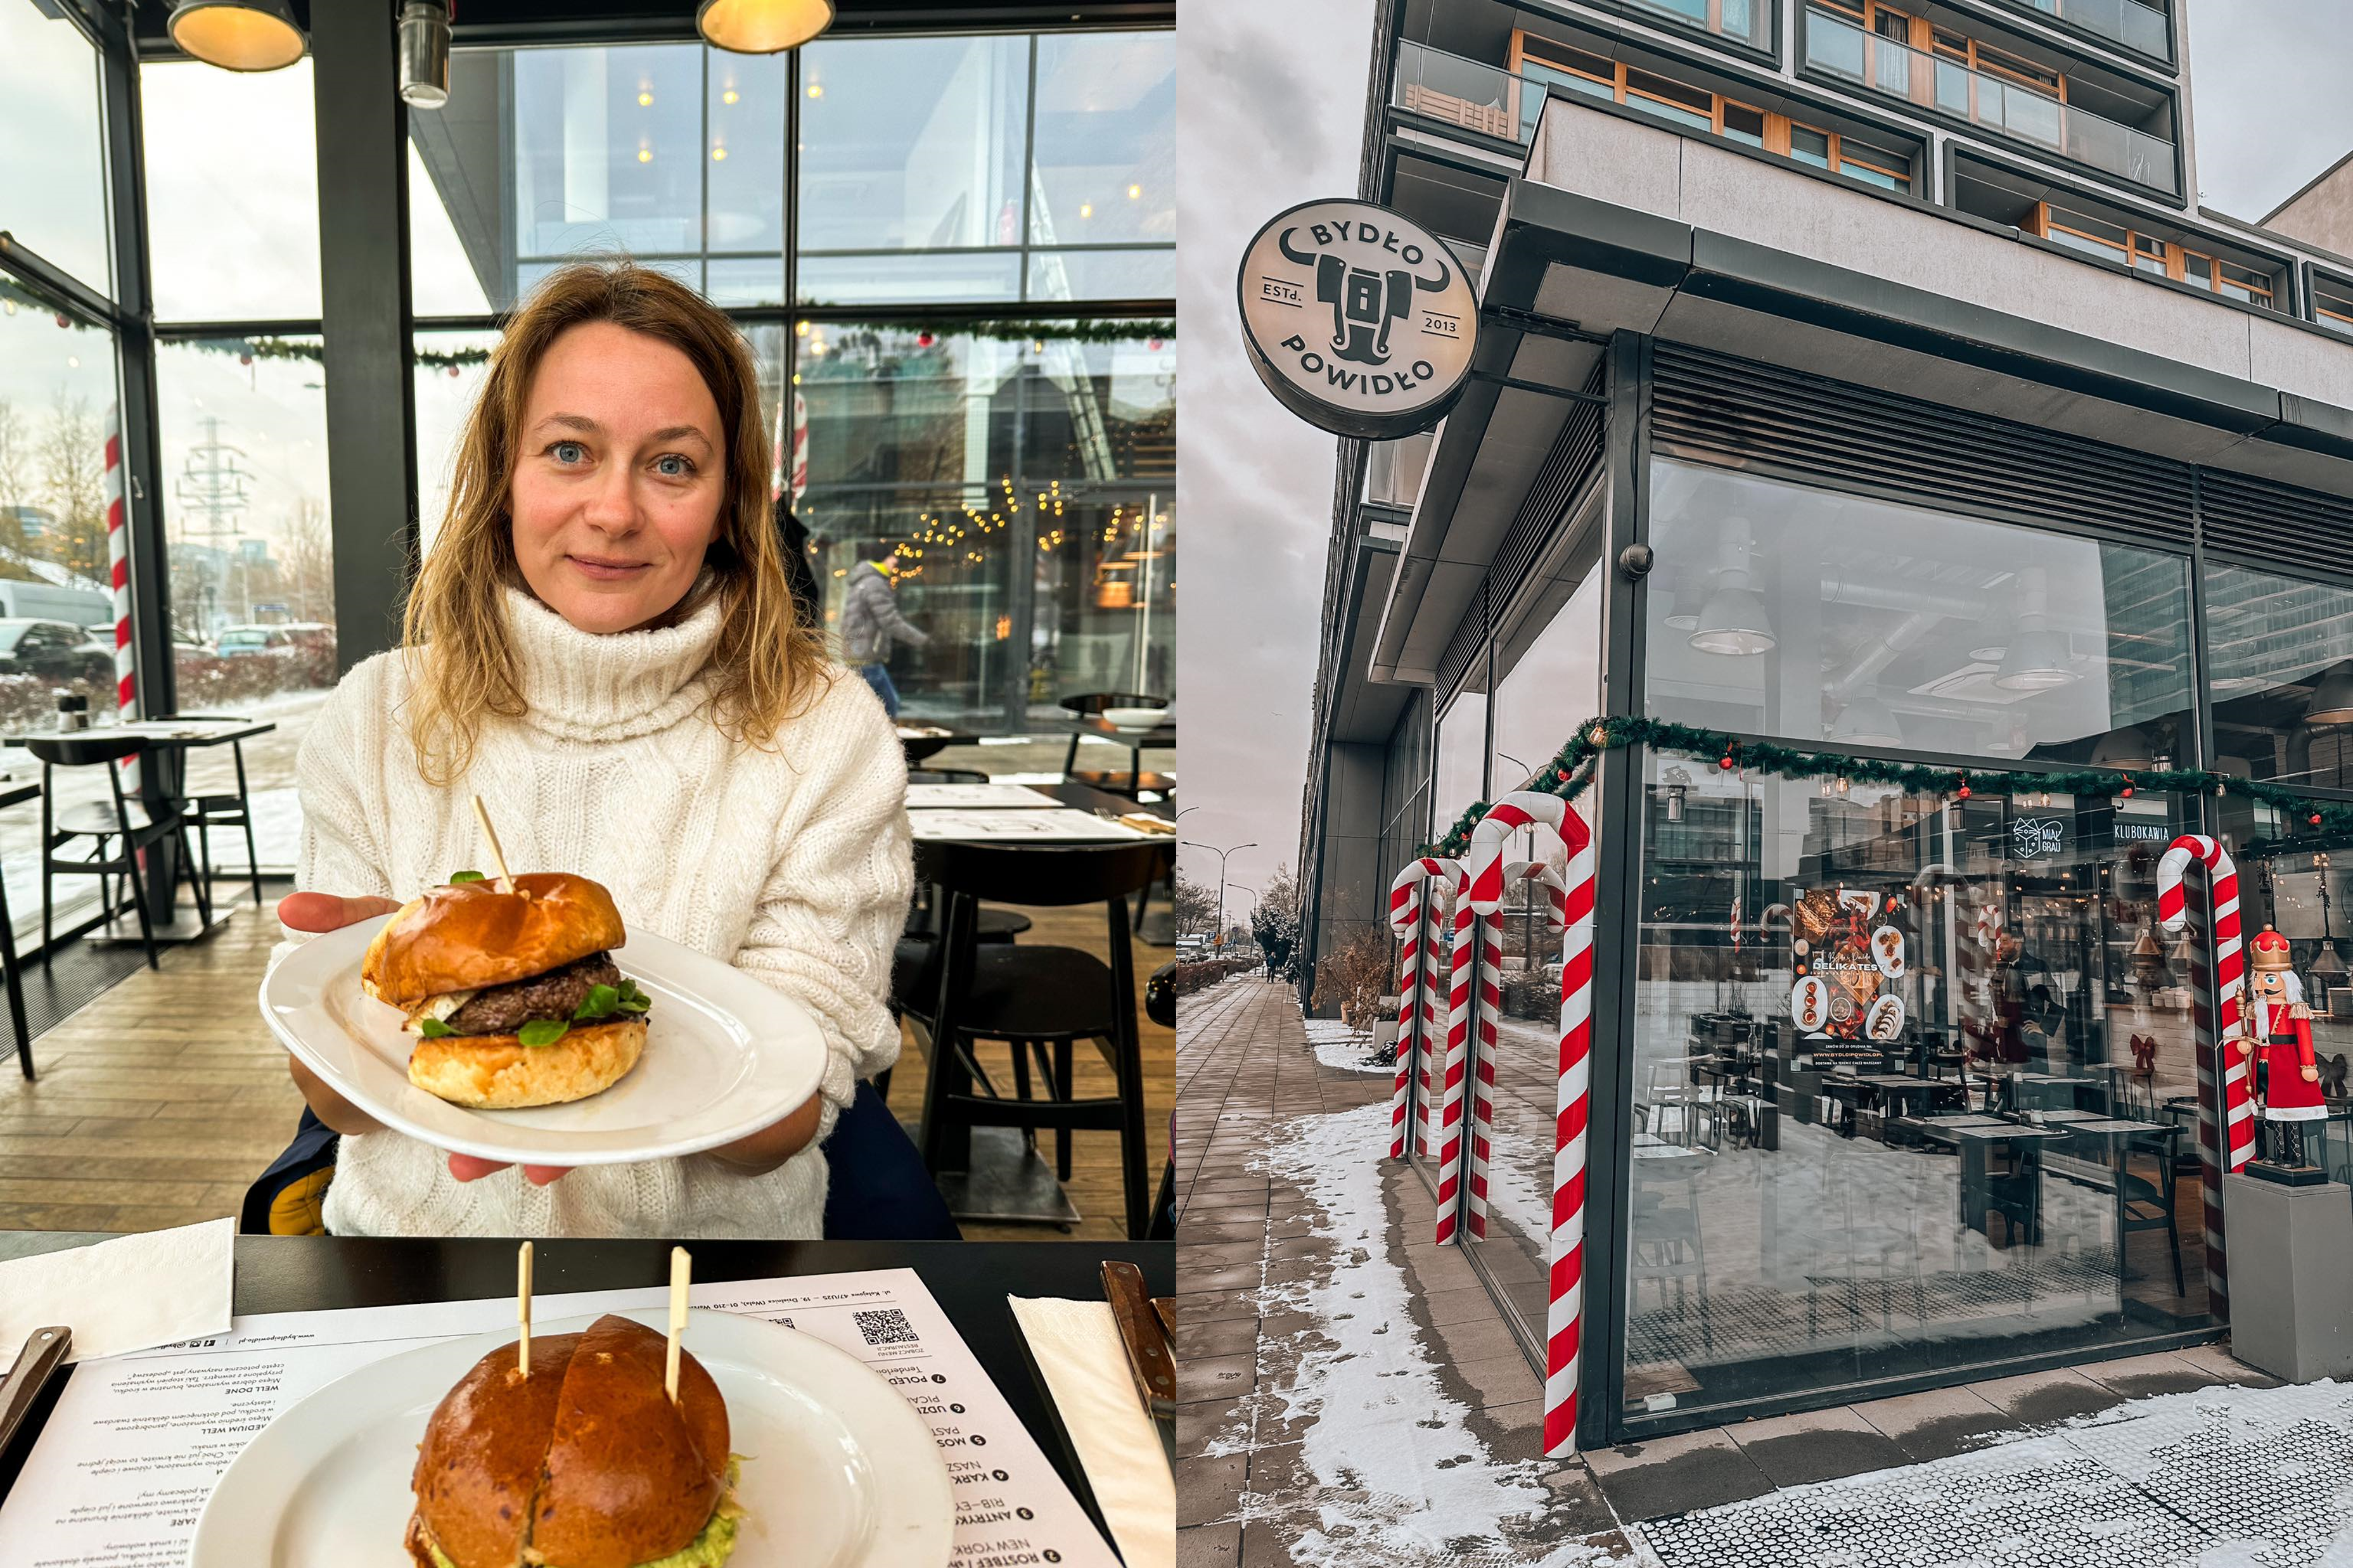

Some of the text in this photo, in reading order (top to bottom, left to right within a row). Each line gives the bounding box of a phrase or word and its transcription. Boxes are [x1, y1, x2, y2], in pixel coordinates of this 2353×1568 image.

[1310, 220, 1423, 265] BYDŁO
[1263, 283, 1302, 302] ESTd.
[1425, 317, 1457, 333] 2013
[1281, 334, 1434, 395] POWIDŁO
[2114, 824, 2169, 840] KLUBOKAWIA
[1812, 962, 1885, 971] DELIKATESY
[238, 1334, 314, 1344] www.bydloipowidlo.pl
[243, 1370, 283, 1379] przypalone
[112, 1379, 155, 1387] wysmażenia
[186, 1380, 230, 1389] wysmażone,
[888, 1375, 927, 1385] POLĘD
[916, 1405, 947, 1414] UDZI
[115, 1422, 170, 1431] jasnobrązowe
[170, 1418, 216, 1427] wysmażone,
[931, 1427, 959, 1436] PAST
[937, 1437, 966, 1447] MOS
[188, 1451, 202, 1460] już
[202, 1451, 224, 1460] Choć
[154, 1460, 203, 1470] wysmażone,
[946, 1460, 982, 1472] NASZ
[951, 1473, 989, 1484] KARK
[137, 1491, 155, 1500] my!
[158, 1487, 199, 1496] polecamy
[118, 1501, 158, 1509] czerwone
[160, 1496, 199, 1506] jaskrawo
[68, 1515, 108, 1524] brunatne
[110, 1512, 153, 1520] delikatnie
[149, 1540, 171, 1548] smak
[952, 1538, 1030, 1555] NEW YORK
[976, 1553, 1040, 1567] ROSTBEF
